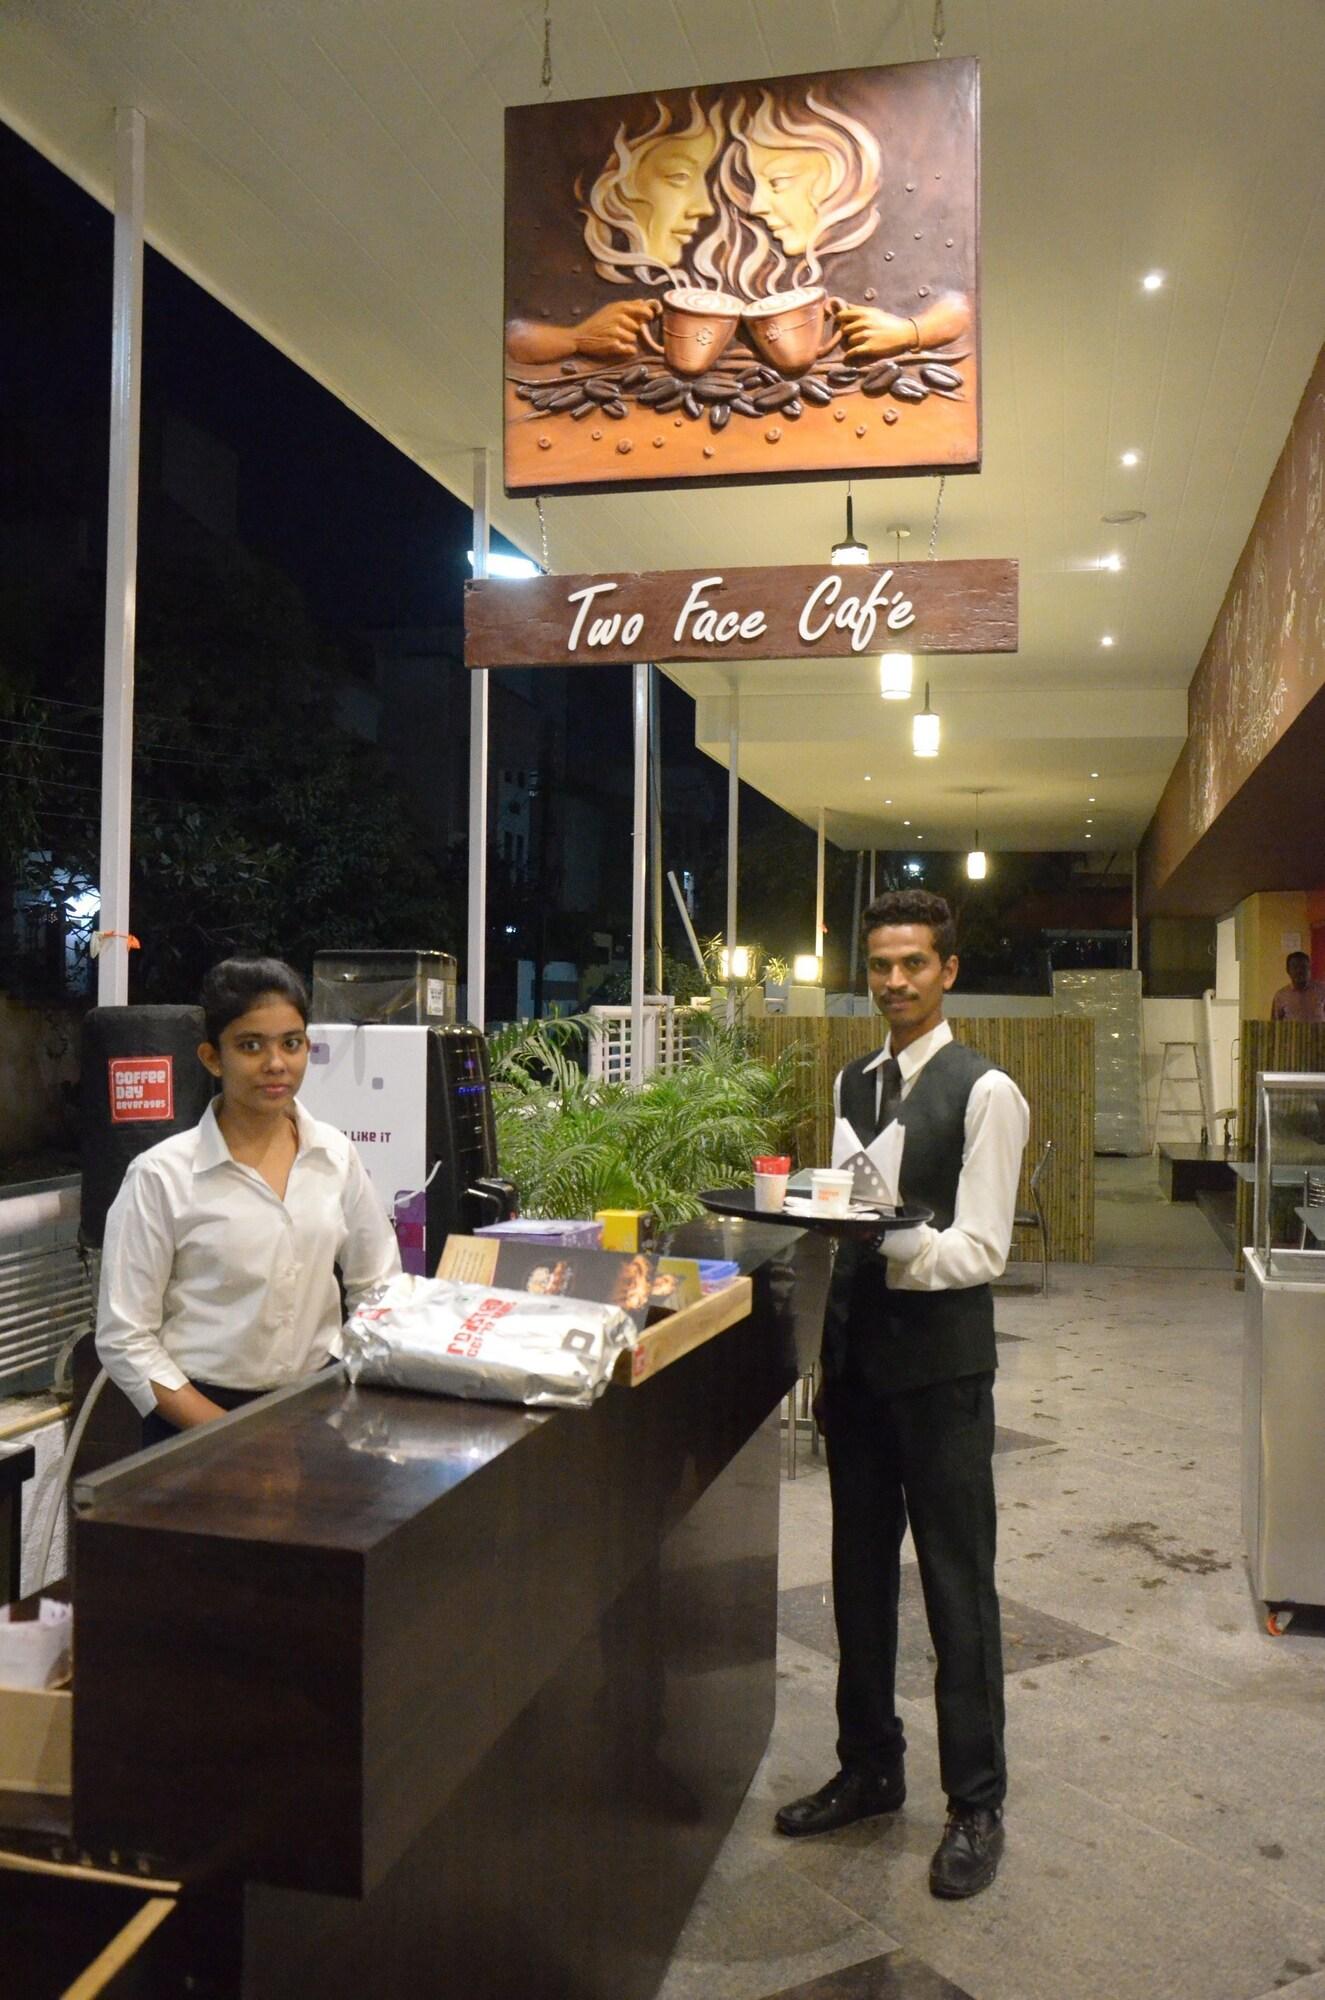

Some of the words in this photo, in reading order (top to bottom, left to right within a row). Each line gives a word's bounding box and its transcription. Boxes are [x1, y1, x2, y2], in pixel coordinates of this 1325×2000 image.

[567, 582, 644, 652] Two
[673, 576, 768, 643] Face
[798, 569, 917, 653] Café
